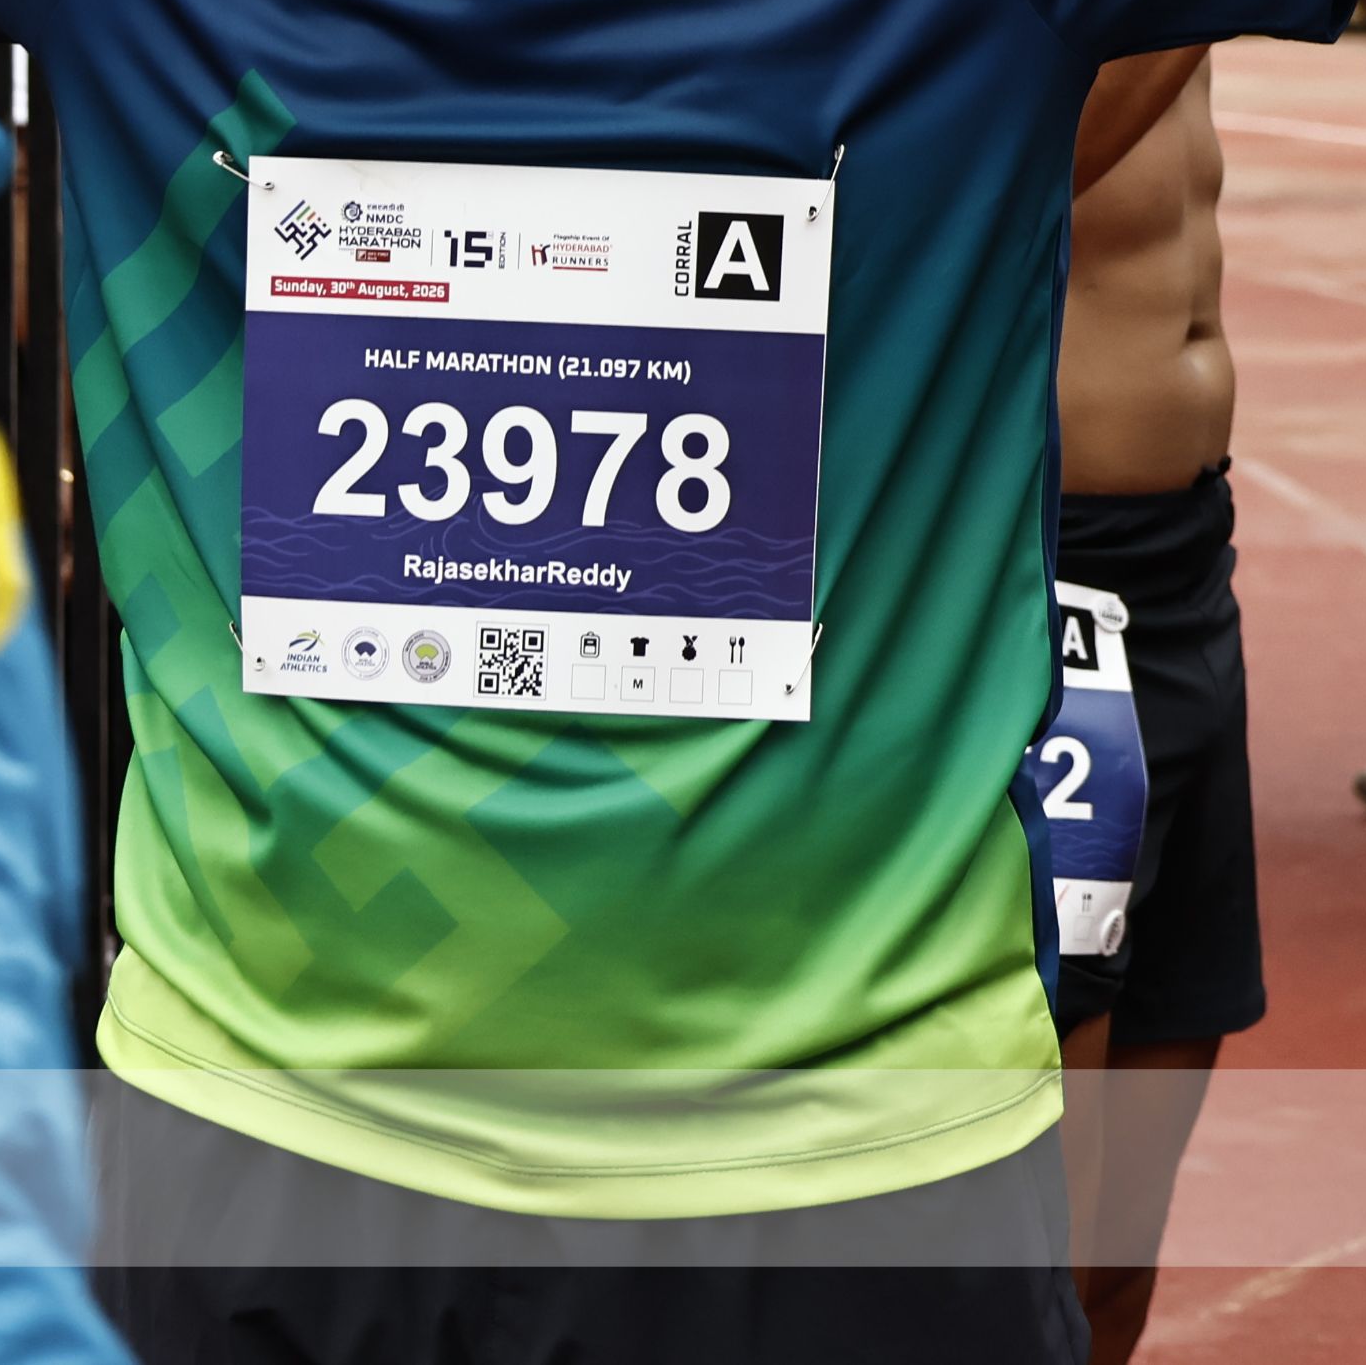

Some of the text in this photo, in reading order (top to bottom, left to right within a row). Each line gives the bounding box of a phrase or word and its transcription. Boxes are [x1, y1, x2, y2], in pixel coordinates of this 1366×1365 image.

[366, 213, 404, 225] NMDC
[338, 225, 422, 238] HYDERABAD
[338, 236, 422, 249] MARATHON
[498, 231, 506, 270] EDITION
[553, 255, 609, 266] RUNNERS
[675, 220, 692, 297] CORRAL
[703, 220, 770, 291] A
[274, 278, 327, 296] Sunday,
[357, 281, 409, 299] August,
[412, 284, 446, 298] 2026
[364, 348, 692, 385] HALF MARATHON (21.097 KM)
[312, 398, 732, 533] 23978
[403, 554, 632, 592] RajasekharReddy
[286, 653, 321, 663] INDIAN
[280, 663, 328, 674] ATHLETICS
[633, 678, 643, 690] M
